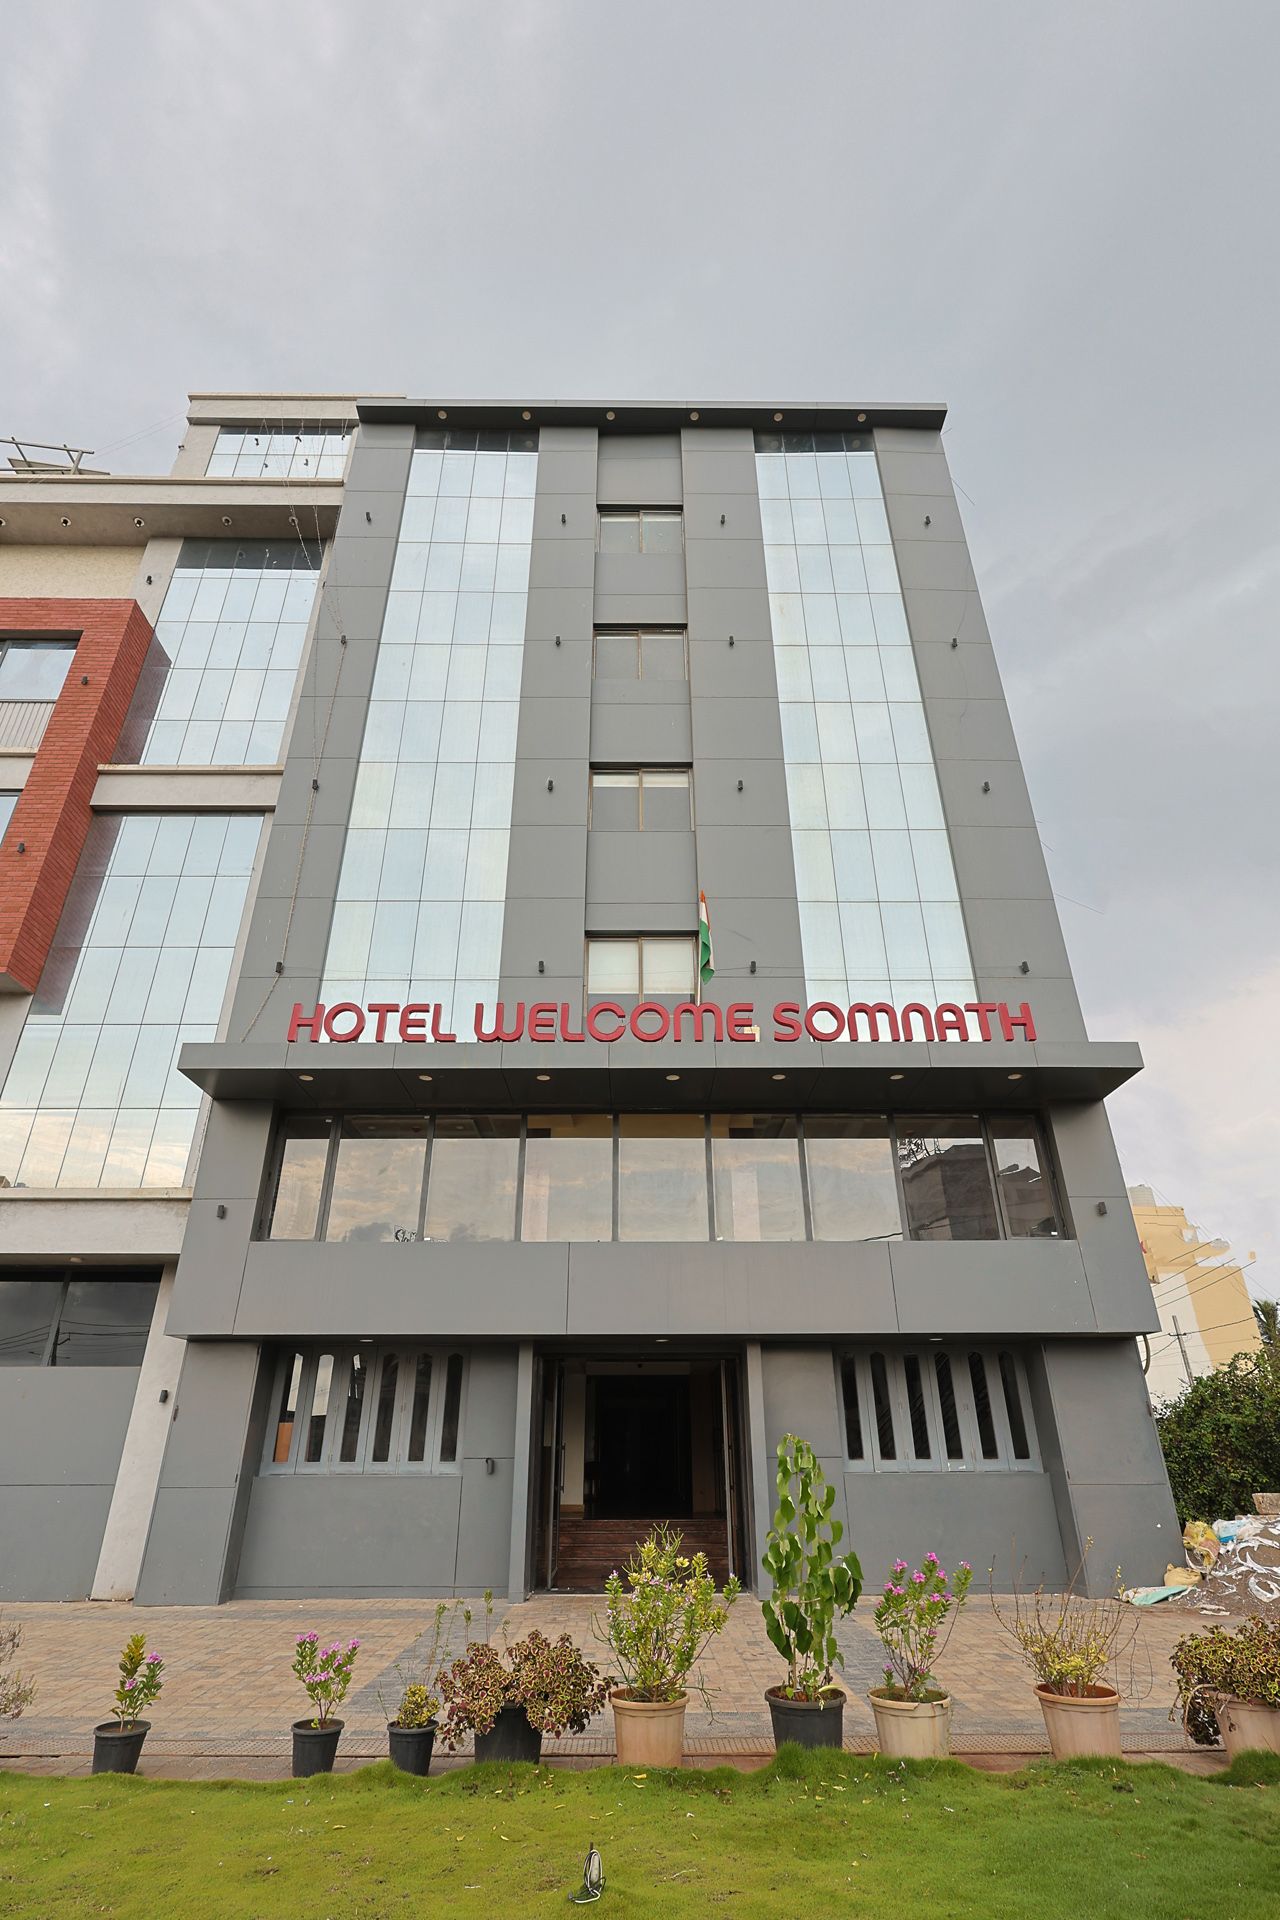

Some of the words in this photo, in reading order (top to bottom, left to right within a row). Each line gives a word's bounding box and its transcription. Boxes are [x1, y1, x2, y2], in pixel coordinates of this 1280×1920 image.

[287, 1002, 457, 1042] HOTEL
[473, 1001, 757, 1042] WELCOME
[773, 1001, 1037, 1041] SOMNATH
